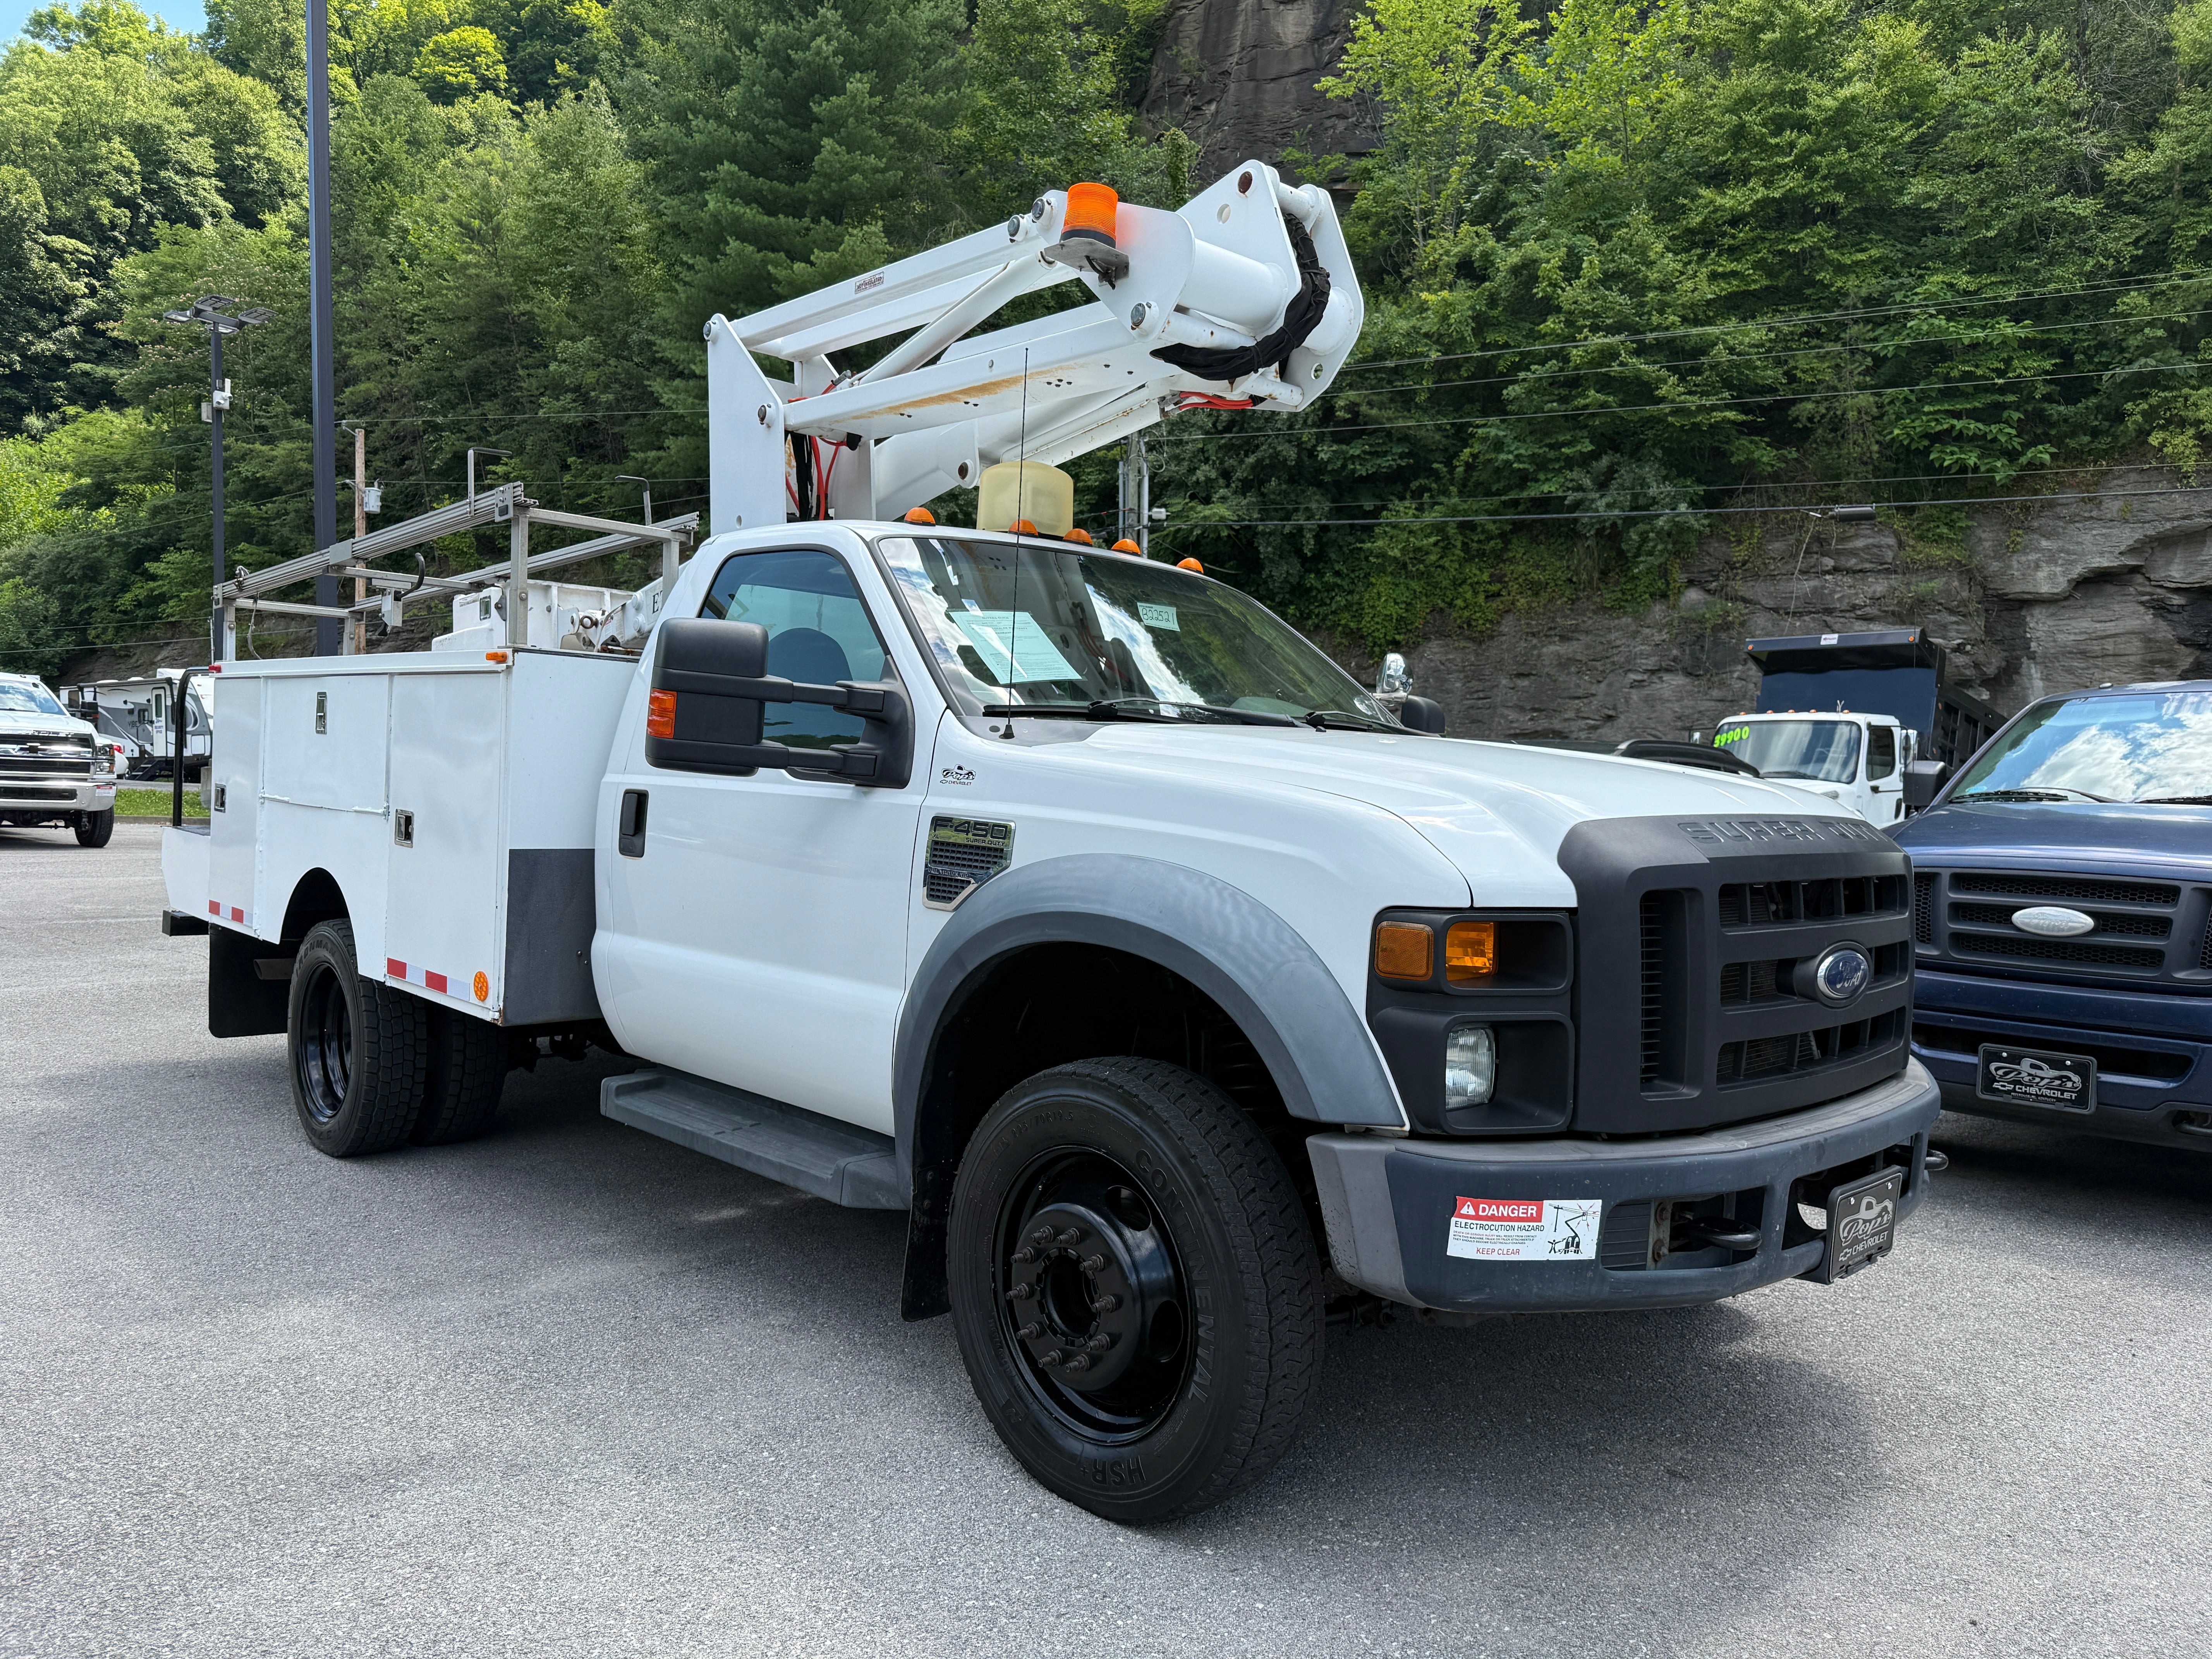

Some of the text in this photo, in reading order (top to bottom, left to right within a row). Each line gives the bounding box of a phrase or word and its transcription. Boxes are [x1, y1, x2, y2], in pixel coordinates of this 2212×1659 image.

[1142, 608, 1175, 625] B22521
[1713, 726, 1749, 748] 39900
[933, 818, 1008, 840] F-450
[1677, 821, 1825, 844] SUPER
[1836, 960, 1864, 989] Ford
[1996, 1068, 2074, 1087] Pop's
[2015, 1085, 2077, 1100] CHEVROLET
[1011, 1109, 1074, 1137] 225/70R19.5
[1479, 1204, 1537, 1217] DANGER
[1455, 1221, 1516, 1231] ELECTROCUTION
[1843, 1212, 1889, 1242] Pop's
[1476, 1247, 1495, 1255] KEEP
[1852, 1231, 1888, 1255] CHEVROLET
[1135, 1149, 1215, 1403] CONTINENTAL
